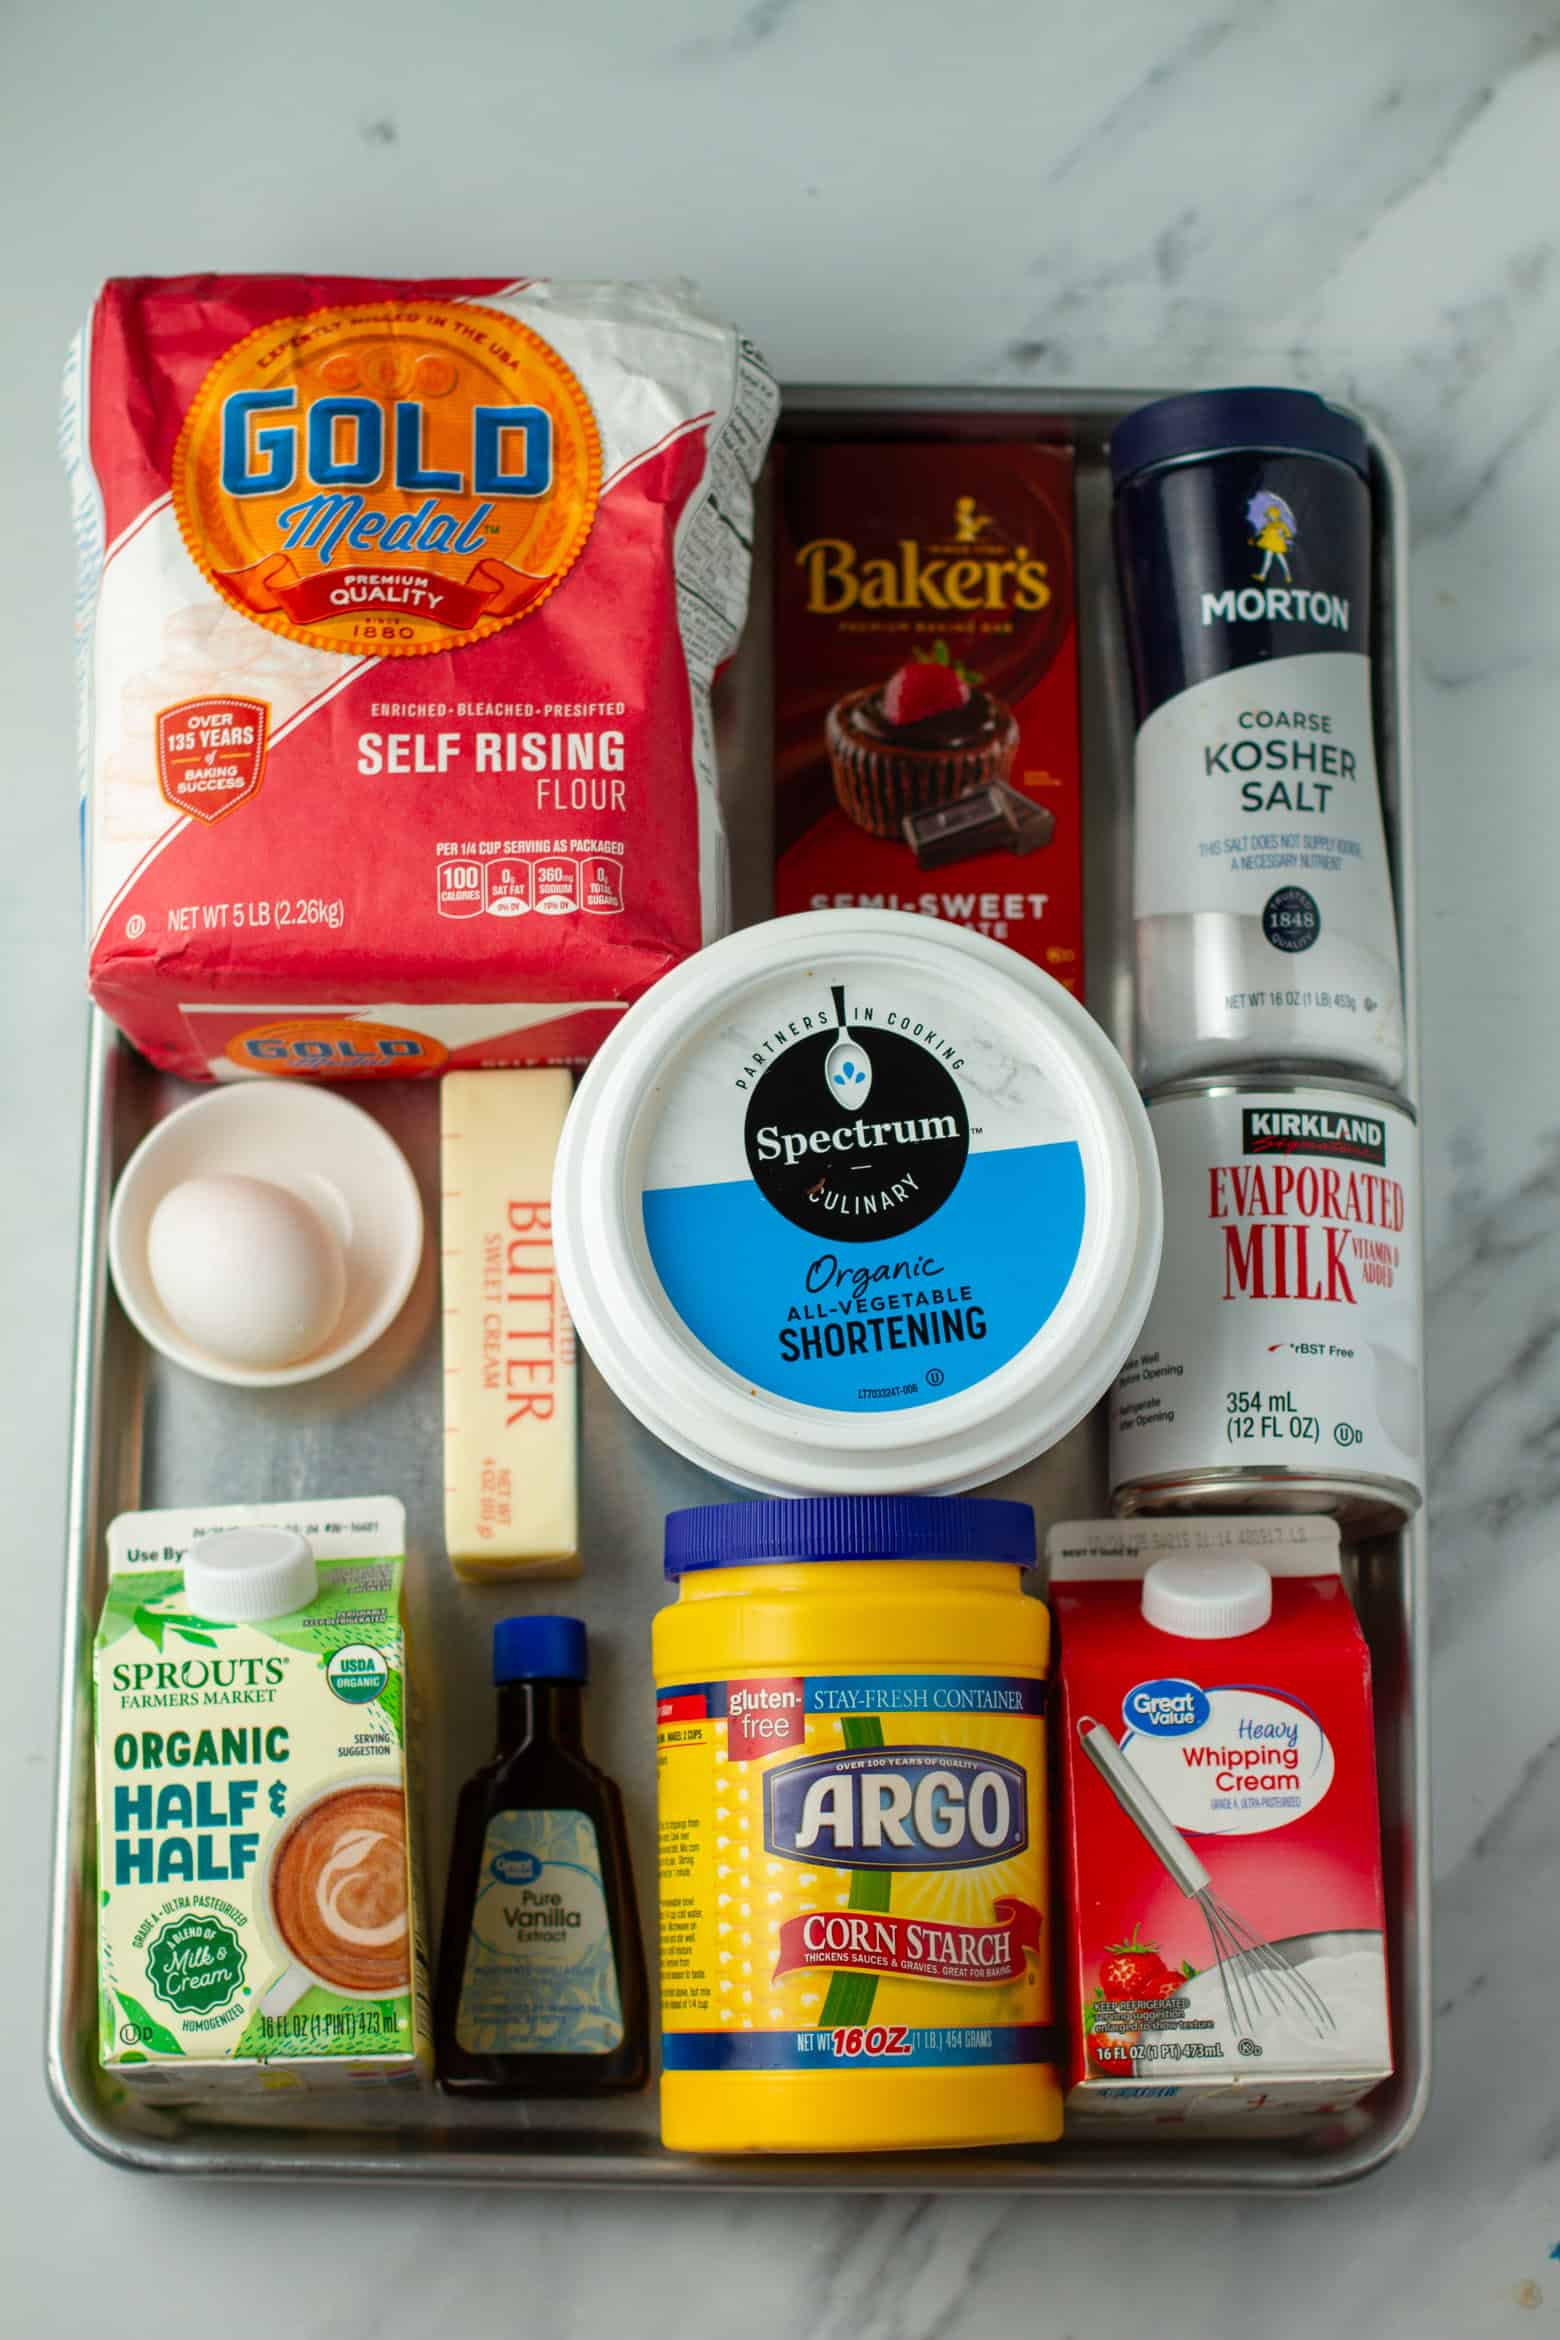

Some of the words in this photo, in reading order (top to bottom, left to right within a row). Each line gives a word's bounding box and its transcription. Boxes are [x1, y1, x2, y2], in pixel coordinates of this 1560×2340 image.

[426, 315, 448, 327] IN
[454, 320, 488, 345] THE
[488, 342, 520, 370] USA
[219, 387, 553, 498] GOLD
[277, 493, 495, 565] Medal
[344, 574, 429, 588] PREMIUM
[795, 538, 1050, 614] Baker's
[330, 586, 443, 610] QUALITY
[1200, 587, 1348, 632] MORTON
[353, 625, 414, 639] 1880
[187, 713, 234, 729] OVER
[1238, 710, 1332, 734] COARSE
[168, 731, 195, 752] 135
[200, 726, 254, 748] YEARS
[357, 731, 461, 775] SELF
[476, 730, 625, 773] RISING
[185, 765, 238, 781] BAKING
[1205, 739, 1357, 783] KOSHER
[177, 776, 245, 794] SUCCESS
[537, 778, 627, 812] FLOUR
[1241, 780, 1334, 814] SALT
[436, 842, 459, 856] PER
[461, 841, 477, 856] 1/4
[479, 841, 501, 856] CUP
[504, 840, 551, 855] SERVING
[554, 839, 567, 853] AS
[570, 838, 625, 856] PACKAGED
[443, 866, 479, 890] 100
[492, 884, 508, 896] SAT
[509, 884, 525, 896] FAT
[168, 906, 200, 932] NET
[203, 903, 230, 930] WT
[233, 902, 245, 928] 5
[249, 901, 271, 927] LB
[274, 898, 345, 930] (2.26kg)
[1270, 911, 1314, 928] 1848
[1250, 992, 1265, 1008] WT
[1270, 991, 1283, 1006] 16
[1286, 991, 1300, 1006] OZ
[244, 1039, 425, 1059] GOLD
[736, 1011, 829, 1089] PARTNERS
[854, 1007, 874, 1021] IN
[887, 1012, 965, 1071] COOKING
[756, 1114, 960, 1166] Spectrum
[1251, 1112, 1382, 1147] KIRKLAND
[808, 1173, 920, 1215] CULINARY
[1208, 1164, 1404, 1232] EVAPORATED
[483, 1231, 502, 1304] SWEET
[806, 1254, 945, 1299] Organic
[1221, 1223, 1358, 1304] MILK
[507, 1199, 554, 1430] BUTTER
[787, 1285, 973, 1322] ALL-VEGETABLE
[779, 1306, 987, 1363] SHORTENING
[483, 1313, 502, 1389] CREAM
[1329, 1344, 1354, 1359] Free
[1227, 1392, 1261, 1413] 354
[1269, 1391, 1297, 1413] mL
[1227, 1417, 1254, 1443] (12
[1261, 1416, 1283, 1438] FL
[1289, 1417, 1320, 1443] OZ)
[127, 1549, 158, 1563] Use
[164, 1548, 183, 1563] By
[113, 1657, 285, 1692] SPROUTS
[341, 1659, 376, 1673] USDA
[336, 1677, 380, 1689] ORGANIC
[121, 1692, 199, 1710] FARMERS
[204, 1689, 277, 1706] MARKET
[729, 1688, 801, 1716] gluten-
[814, 1687, 926, 1711] STAY-FRESH
[934, 1688, 1025, 1711] CONTAINER
[1133, 1692, 1195, 1714] Great
[742, 1713, 789, 1739] free
[1148, 1710, 1194, 1727] Value
[354, 1733, 391, 1745] SERVING
[1238, 1718, 1299, 1748] Heavy
[114, 1726, 290, 1770] ORGANIC
[337, 1744, 391, 1758] SUGGESTION
[1182, 1745, 1299, 1769] Whipping
[836, 1760, 865, 1772] OVER
[868, 1760, 886, 1768] 100
[888, 1758, 921, 1767] YEARS
[925, 1758, 938, 1766] OF
[939, 1759, 977, 1770] QUALITY
[1215, 1771, 1300, 1792] Cream
[114, 1780, 259, 1832] HALF
[795, 1770, 1010, 1848] ARGO
[115, 1833, 260, 1885] HALF
[521, 1889, 562, 1907] Pure
[132, 1917, 152, 1949] GRADE
[150, 1912, 160, 1923] A
[162, 1896, 191, 1915] ULTRA
[193, 1894, 249, 1927] PASTEURIZED
[503, 1906, 581, 1928] Vanilla
[166, 1941, 176, 1951] A
[172, 1926, 202, 1944] BLEND
[204, 1927, 217, 1940] OF
[802, 1914, 897, 1953] CORN
[906, 1924, 1012, 1968] STARCH
[163, 1945, 214, 1976] Milk
[216, 1946, 228, 1961] &
[804, 1953, 849, 1963] THICKENS
[851, 1955, 889, 1966] SAUCES
[891, 1958, 898, 1968] &
[942, 1966, 968, 1978] GREAT
[970, 1967, 985, 1978] FOR
[166, 1968, 232, 1996] Cream
[182, 2003, 246, 2033] HOMOGENIZED
[261, 2015, 274, 2039] 16
[277, 2015, 289, 2038] FL
[293, 2014, 308, 2038] OZ
[325, 2012, 356, 2040] PINT)
[383, 2011, 400, 2033] mL
[797, 2032, 814, 2053] NET
[945, 2030, 962, 2049] 454
[965, 2030, 993, 2049] GRAMS
[1097, 2047, 1111, 2061] 16
[1114, 2046, 1127, 2060] FL
[1130, 2045, 1146, 2060] OZ
[1160, 2043, 1181, 2061] PT)
